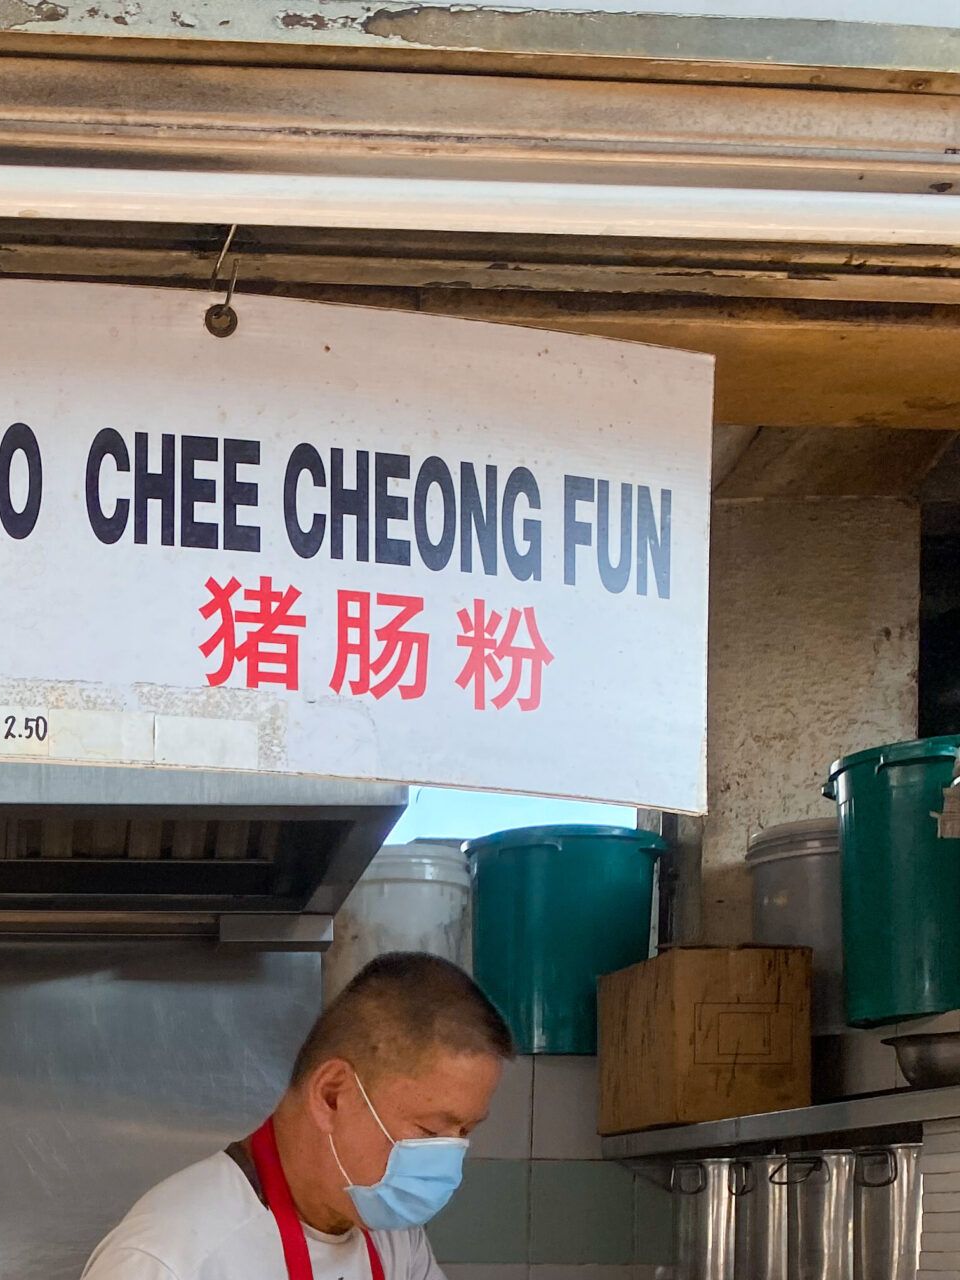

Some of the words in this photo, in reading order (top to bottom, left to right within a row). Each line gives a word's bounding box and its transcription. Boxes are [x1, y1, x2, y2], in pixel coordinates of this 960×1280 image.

[85, 427, 261, 553] CHEE
[283, 443, 542, 582] CHEONG
[563, 474, 672, 600] FUN
[198, 575, 555, 712] 猪肠粉
